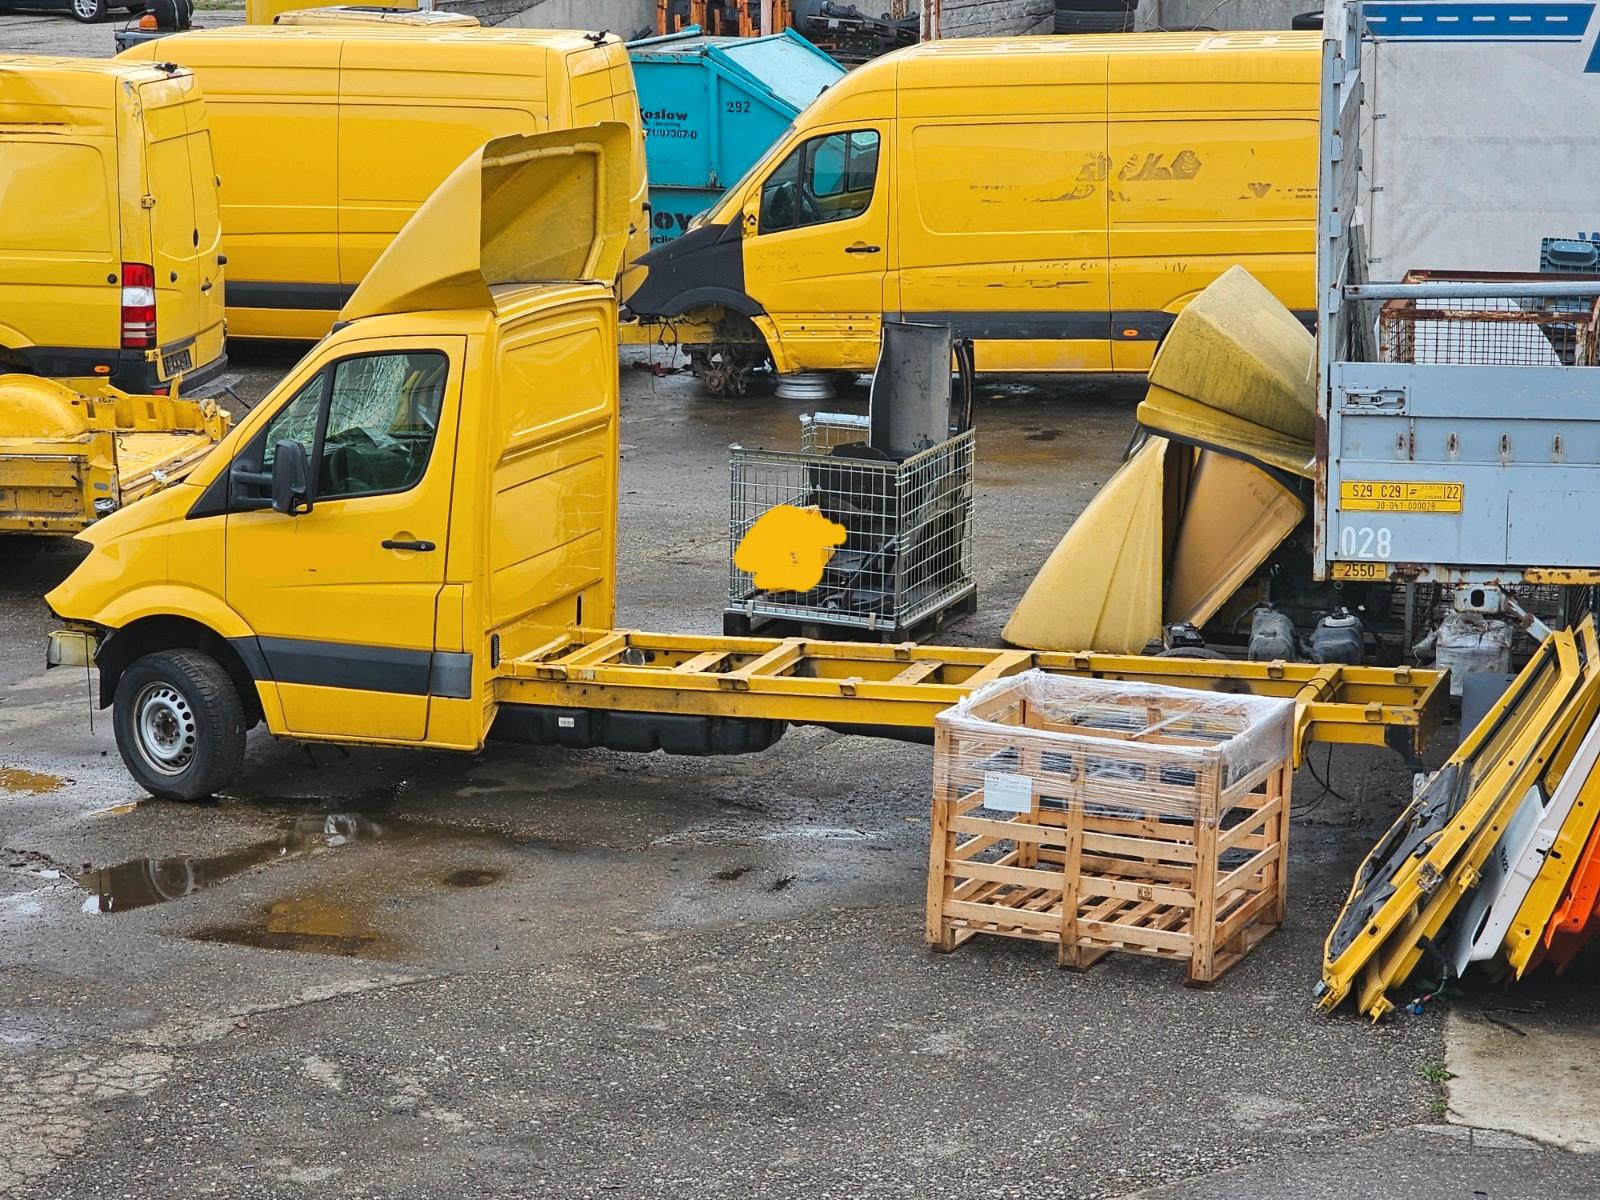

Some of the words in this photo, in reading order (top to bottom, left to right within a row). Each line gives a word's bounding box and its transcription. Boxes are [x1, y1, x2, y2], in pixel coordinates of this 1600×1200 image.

[726, 101, 751, 113] 292
[1352, 484, 1373, 497] S29
[1381, 484, 1401, 498] C29
[1446, 486, 1459, 499] 22
[1341, 526, 1392, 558] 028
